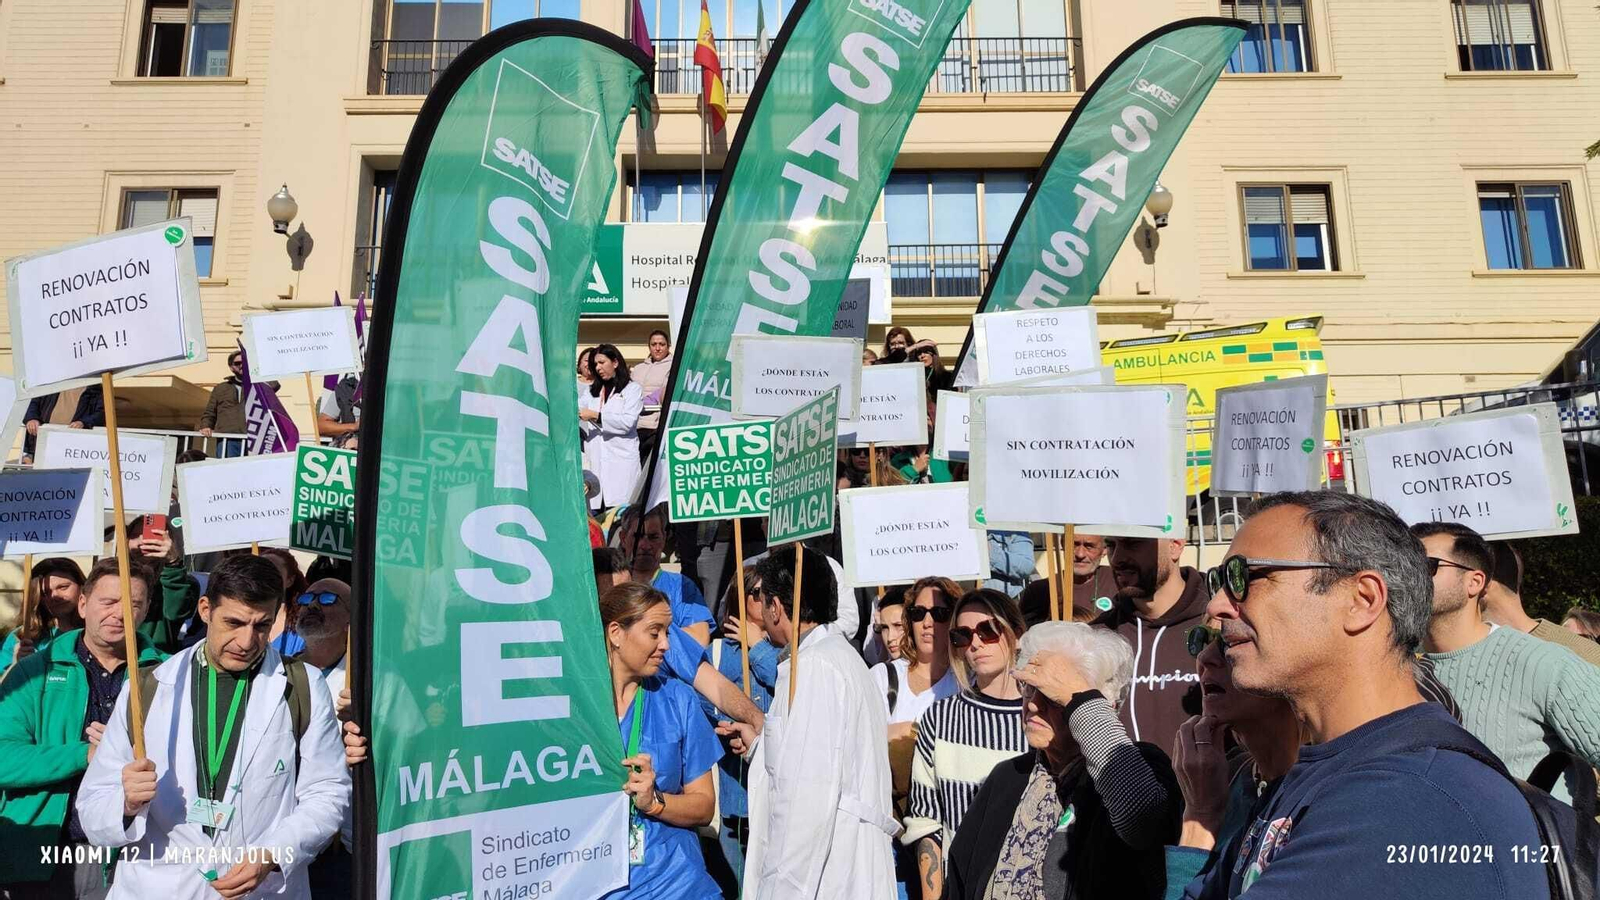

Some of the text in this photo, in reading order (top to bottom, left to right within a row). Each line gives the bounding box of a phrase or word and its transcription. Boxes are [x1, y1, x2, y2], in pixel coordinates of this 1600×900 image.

[1136, 78, 1181, 110] SATSE
[493, 137, 570, 204] SATSE
[726, 32, 900, 361] SATSE
[1014, 105, 1159, 310] SATSE
[631, 254, 683, 267] Hospital
[41, 258, 151, 300] RENOVACIÓN
[631, 276, 690, 291] Hospital
[586, 295, 620, 304] Andalucía
[837, 300, 858, 311] NIDAD
[49, 292, 149, 330] CONTRATOS
[1016, 317, 1059, 328] RESPETO
[88, 334, 108, 352] YA
[1026, 333, 1054, 343] A LOS
[1015, 349, 1067, 360] DERECHOS
[1113, 350, 1216, 370] AMBULANCIA
[761, 367, 830, 378] ¿DÓNDE ESTÁN
[1015, 364, 1070, 376] LABORALES
[682, 369, 732, 401] MÁL
[755, 387, 773, 396] LOS
[870, 394, 897, 404] ESTÁN
[858, 413, 904, 422] NTRATOS?
[1231, 407, 1296, 426] RENOVACIÓN
[775, 396, 838, 462] SATSE
[1007, 436, 1135, 451] SIN CONTRATACIÓN
[1231, 436, 1290, 451] CONTRATOS
[454, 196, 571, 727] SATSE
[1392, 439, 1513, 469] RENOVACIÓN
[674, 457, 766, 477] SINDICATO
[773, 446, 832, 484] SINDICATO DE
[1021, 466, 1120, 480] MOVILIZACIÓN
[1251, 463, 1260, 477] YA
[773, 467, 831, 504] ENFERMERIA
[1402, 470, 1512, 496] CONTRATOS
[249, 487, 281, 499] ESTÁN
[676, 488, 770, 517] MALAG
[1448, 504, 1470, 519] YA
[0, 510, 72, 523] ONTRATOS
[204, 507, 290, 523] LOS CONTRATOS?
[772, 491, 829, 538] MALAGA
[23, 531, 40, 542] YA
[875, 519, 950, 537] ¿DÓNDE ESTÁN
[870, 541, 959, 557] LOS CONTRATOS?
[399, 744, 604, 806] MÁLAGA
[481, 825, 571, 855] Sindicato
[483, 841, 612, 881] de Enfermería
